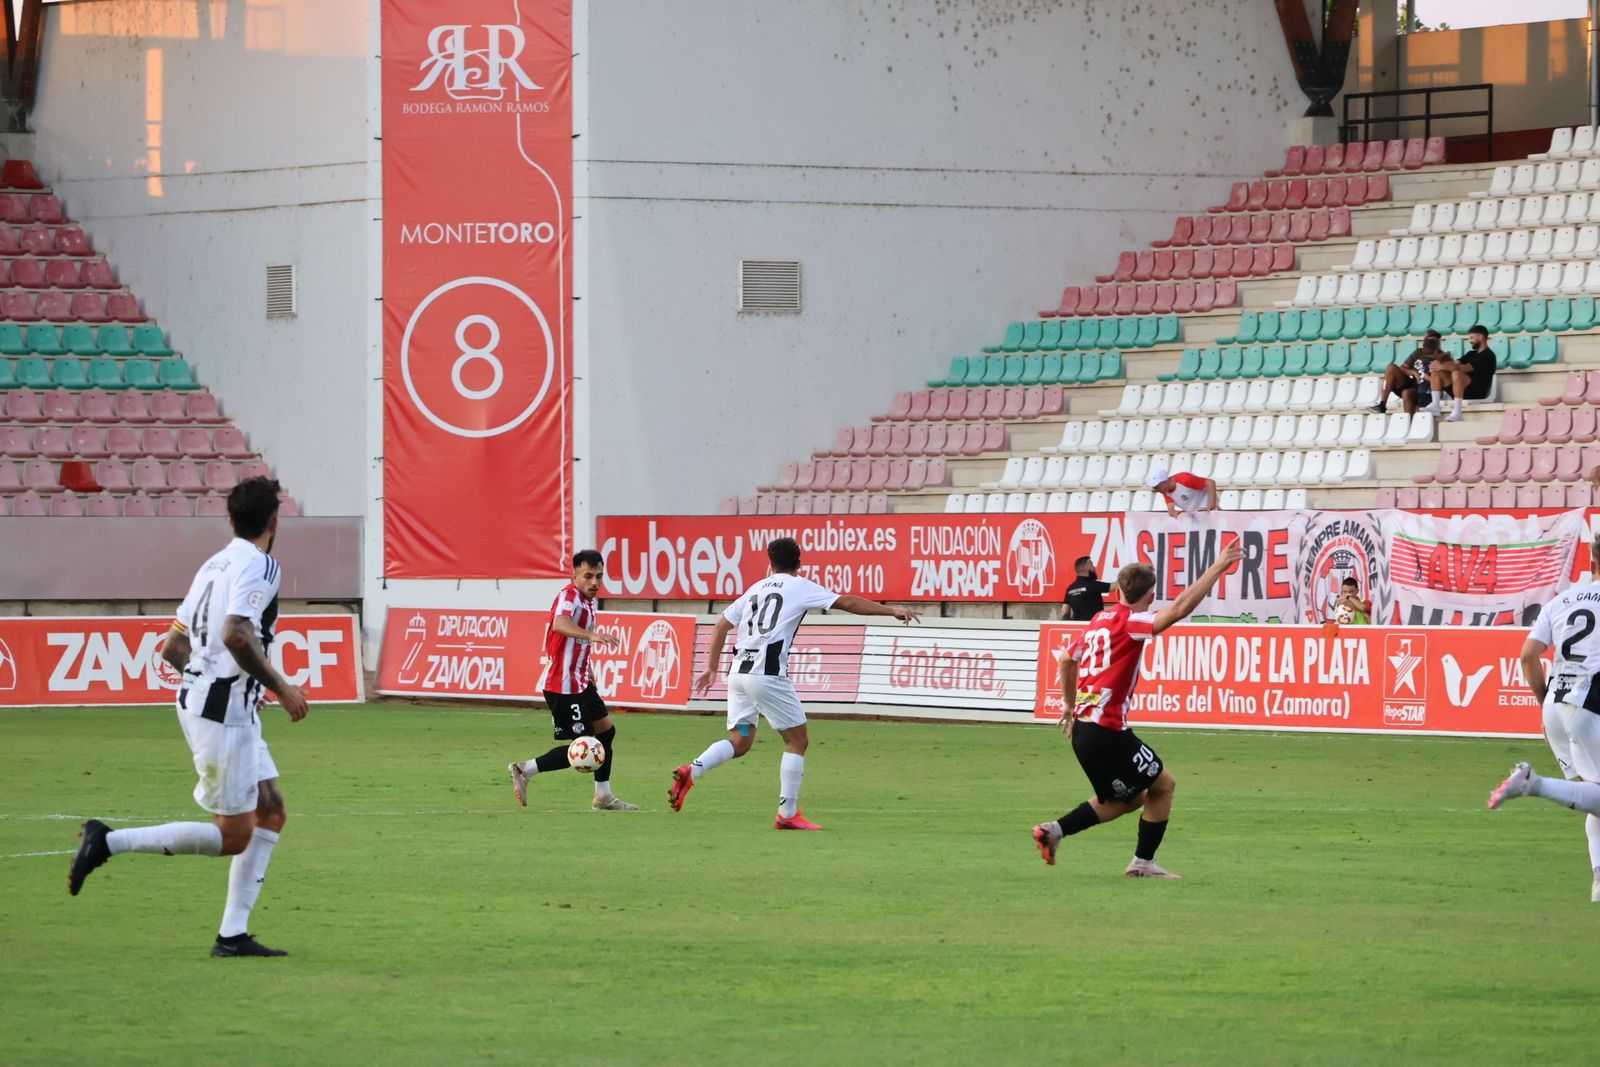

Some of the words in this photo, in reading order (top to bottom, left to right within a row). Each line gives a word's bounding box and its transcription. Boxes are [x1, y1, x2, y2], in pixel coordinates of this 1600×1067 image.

[403, 103, 452, 114] BODEGA
[456, 102, 502, 113] RAMON
[507, 101, 549, 113] RAMOS
[400, 222, 554, 244] MONTETORO
[451, 314, 504, 400] 8
[911, 518, 1001, 555] FUNDACIÓN
[1304, 520, 1341, 589] SIEMPRE
[1342, 520, 1378, 590] AMANECE
[600, 521, 743, 596] cubiex
[911, 560, 1001, 597] ZAMORACF
[1427, 541, 1499, 594] AV4
[824, 565, 852, 593] 630
[857, 565, 884, 593] 110
[192, 581, 214, 647] 4
[749, 593, 783, 636] 10
[1078, 628, 1112, 677] 20
[1562, 608, 1596, 663] 2
[422, 655, 505, 691] ZAMORA
[889, 636, 996, 692] lantania
[1139, 635, 1228, 682] CAMINO
[1234, 636, 1262, 682] DE
[1268, 637, 1296, 683] LA
[1303, 637, 1370, 685] PLATA
[570, 704, 582, 720] 3
[1128, 685, 1180, 711] orales
[1186, 685, 1212, 712] del
[1218, 688, 1257, 714] Vino
[1263, 689, 1350, 720] (Zamora)
[1499, 695, 1510, 706] EL
[1132, 744, 1154, 773] 20
